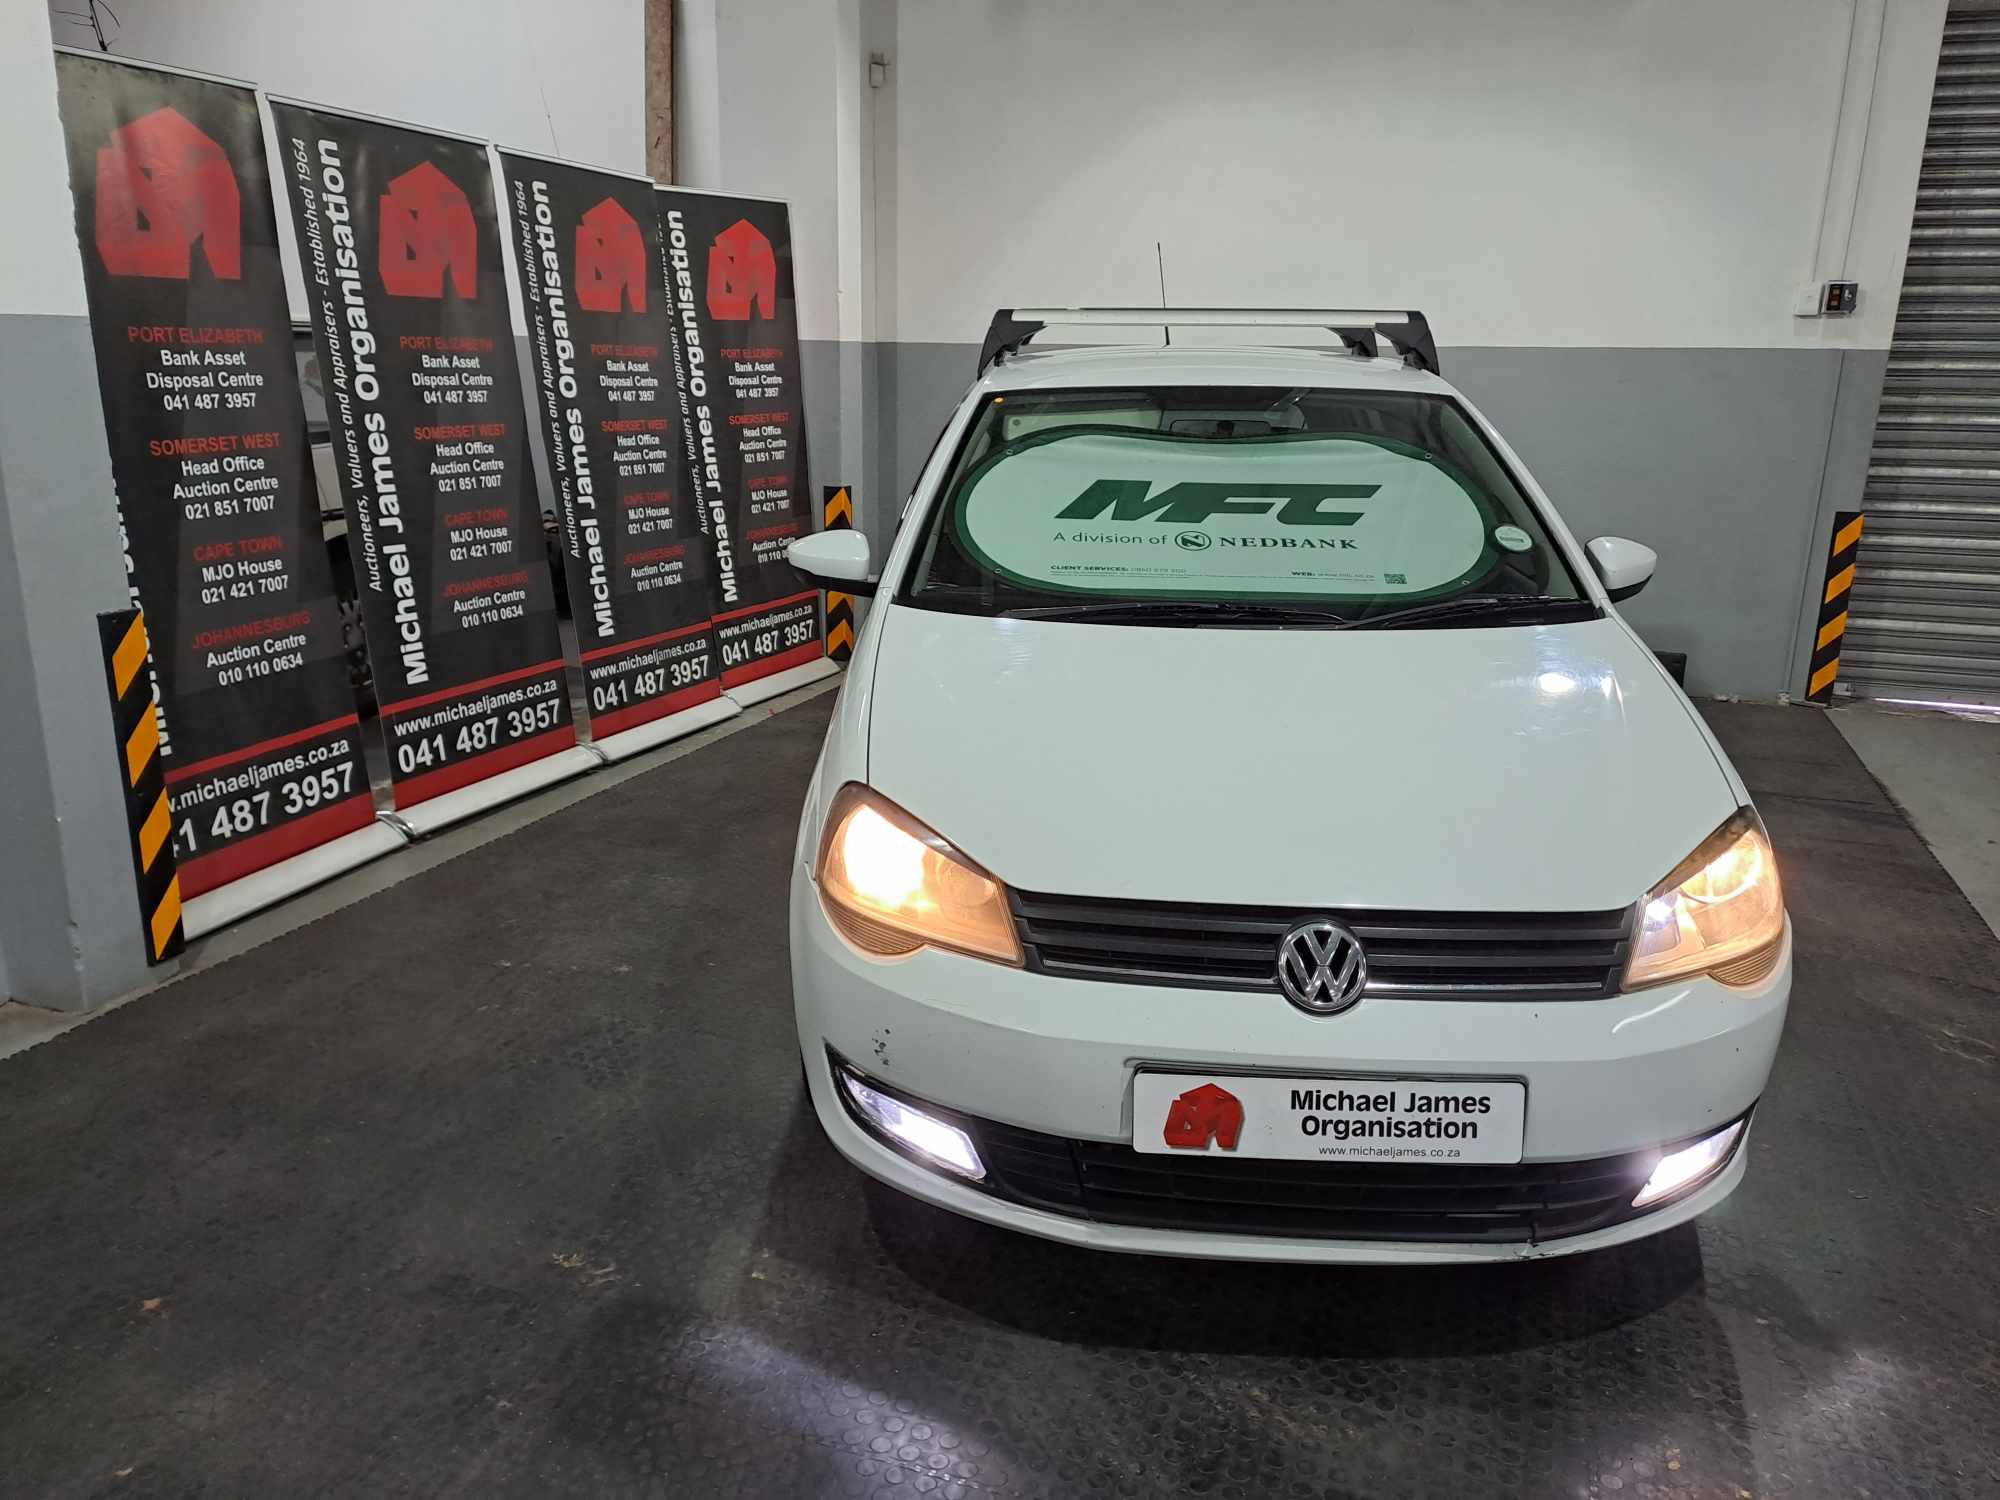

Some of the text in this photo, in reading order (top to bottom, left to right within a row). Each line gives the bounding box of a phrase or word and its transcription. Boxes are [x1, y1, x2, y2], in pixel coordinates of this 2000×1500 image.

[127, 326, 264, 344] PORT ELIZABETH
[160, 349, 246, 366] Bank Asset
[291, 138, 382, 591] Auctioneers, Valuers and Appraisers Established 1964
[422, 355, 480, 368] Bank Asset
[514, 180, 581, 558] Auctioneers, Valuers and Appraisers Established 1964
[606, 360, 649, 372] Bank Asset
[146, 371, 264, 391] Disposal Centre
[411, 372, 493, 388] Disposal Centre
[600, 375, 659, 389] Disposal Centre
[164, 393, 256, 411] 041 487 3957
[424, 390, 487, 404] 041 487 3957
[608, 390, 655, 402] 041 487 3957
[667, 210, 738, 602] Michael James Organisation
[680, 391, 690, 415] and
[318, 140, 430, 686] Michael James Organisation
[531, 180, 615, 637] Michael James Organisation
[149, 433, 280, 456] SOMERSET WEST
[415, 426, 475, 440] SOMERSET
[617, 434, 660, 447] Head Office
[683, 418, 697, 461] Valuers
[436, 441, 494, 457] Head Office
[613, 449, 667, 462] Auction Centre
[181, 456, 265, 477] Head Office
[430, 459, 504, 476] Auction Centre
[619, 462, 665, 477] 021 851 7007
[173, 476, 279, 500] Auction Centre
[438, 474, 501, 493] 021 851 7007
[185, 495, 275, 520] 021 851 7007
[690, 465, 709, 535] Auctioneers,
[1054, 479, 1383, 526] MFC
[628, 506, 670, 520] MJO House
[450, 526, 508, 544] MJO House
[628, 518, 673, 535] 021 421 7007
[193, 536, 282, 561] CAPE TOWN
[450, 541, 512, 561] 021 421 7007
[1053, 531, 1358, 550] A division of NEDBANK
[202, 557, 282, 583] MJO House
[631, 561, 683, 578] Auction Centre
[201, 575, 289, 605] 021 421 7007
[637, 573, 682, 592] 010 110 0634
[453, 589, 525, 612] Auction Centre
[462, 605, 523, 628] 010 110 0634
[719, 604, 813, 639] www.michaeljames.co.za
[206, 633, 307, 668] Auction Centre
[722, 619, 814, 666] 041 487 3957
[218, 652, 304, 686] 010 110 0634
[590, 638, 706, 680] www.michaeljames.co.za
[593, 654, 710, 712] 041 487 3957
[394, 679, 557, 736] www.michaeljames.co.za
[398, 698, 560, 773] 041 487 3957
[211, 791, 270, 838] 487
[282, 761, 353, 814] 3957
[1290, 1089, 1491, 1114] Michael James
[1301, 1114, 1478, 1141] Organisation
[1319, 1145, 1461, 1159] www.michaeljames.co.za
